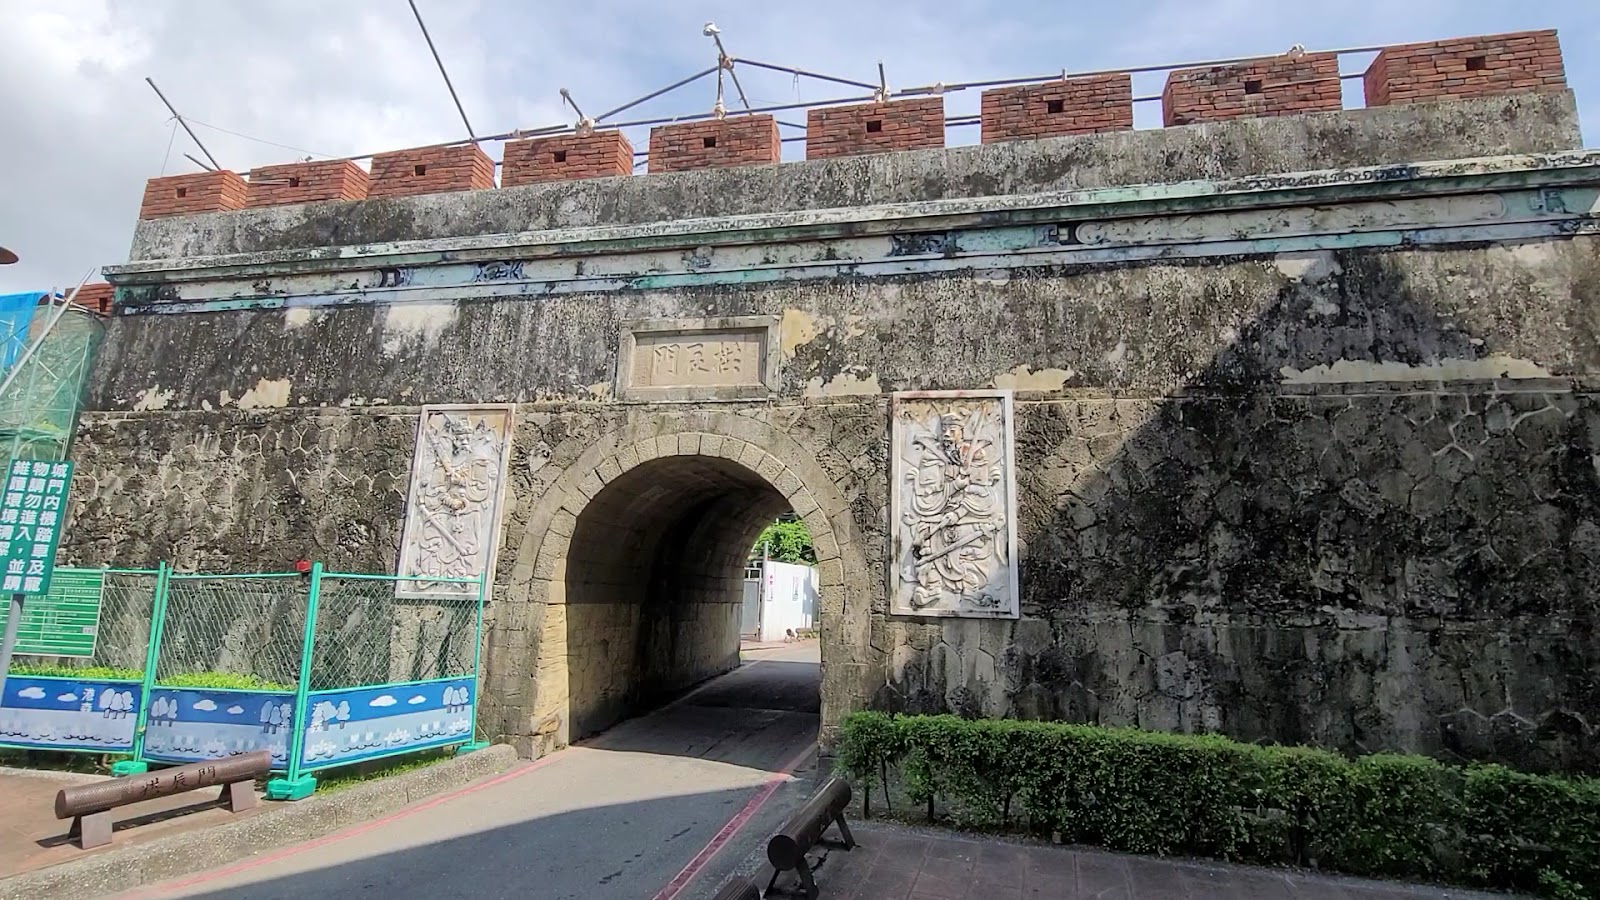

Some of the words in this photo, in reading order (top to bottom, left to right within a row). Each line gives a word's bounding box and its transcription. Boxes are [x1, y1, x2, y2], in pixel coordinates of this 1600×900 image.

[23, 462, 69, 592] 城門內機踏車及寵
